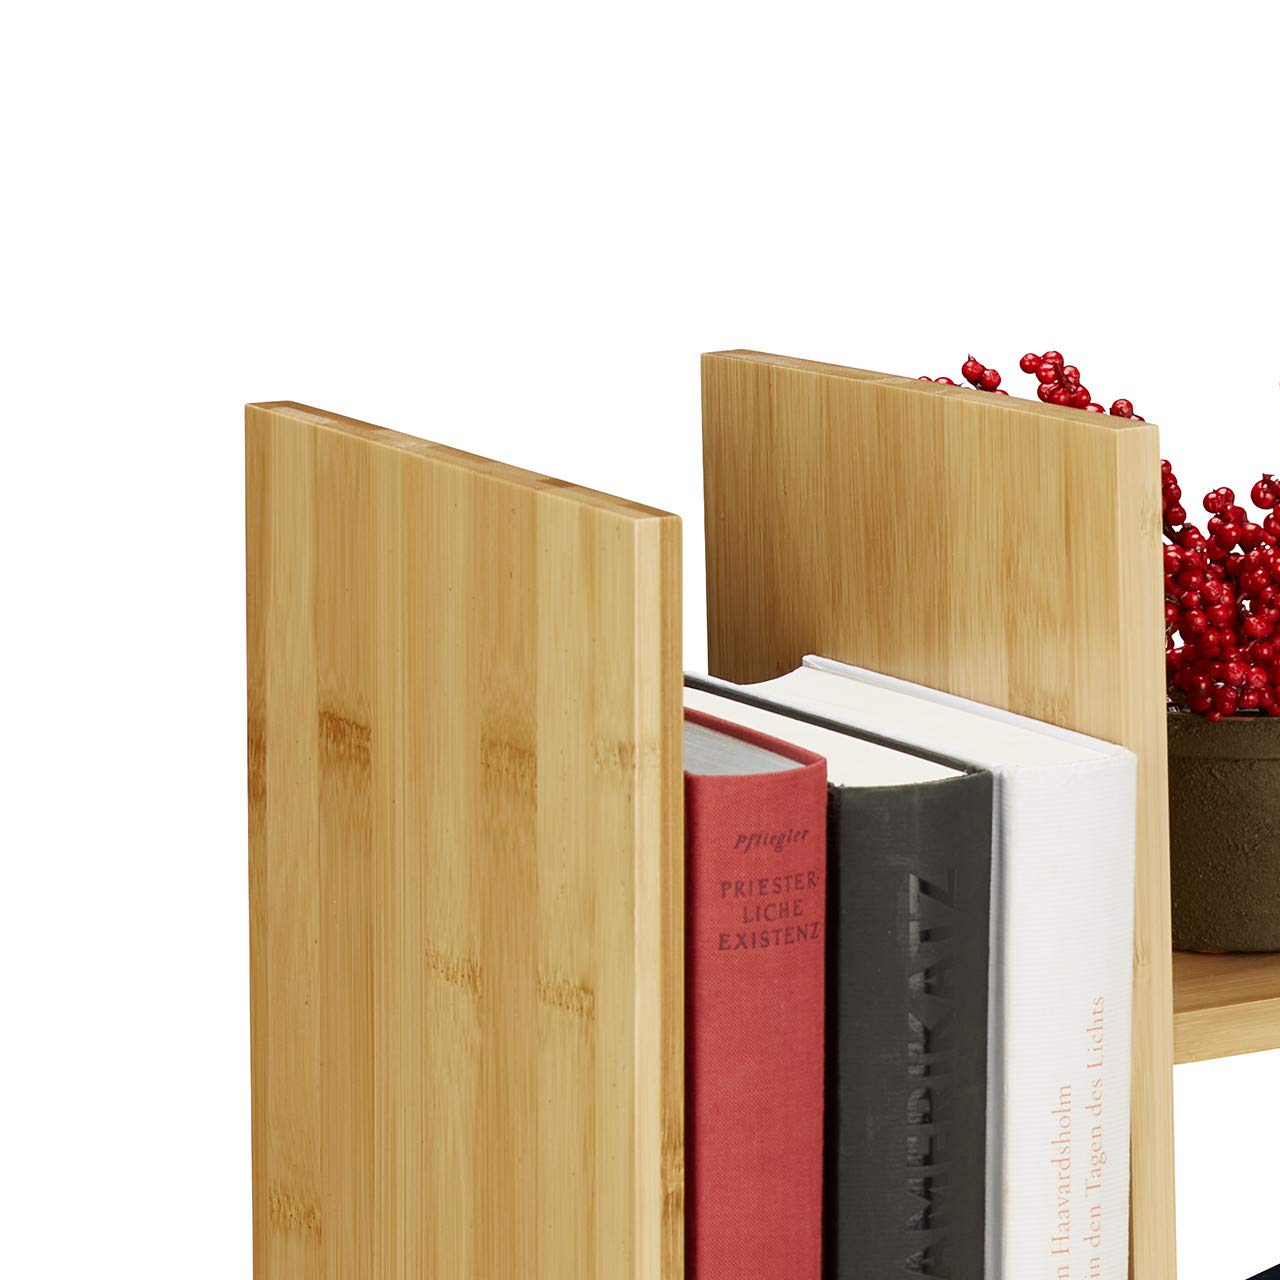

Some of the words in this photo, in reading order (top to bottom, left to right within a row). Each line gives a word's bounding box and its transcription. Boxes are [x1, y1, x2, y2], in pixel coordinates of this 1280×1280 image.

[735, 829, 809, 853] Pfliegler
[743, 899, 804, 924] LICHE
[719, 921, 820, 951] EXISTENZ
[1086, 996, 1105, 1070] Lichts
[1085, 1078, 1103, 1121] des
[1051, 1083, 1073, 1256] Haavardsholm
[1085, 1124, 1107, 1199] Tagen
[1083, 1204, 1102, 1249] den
